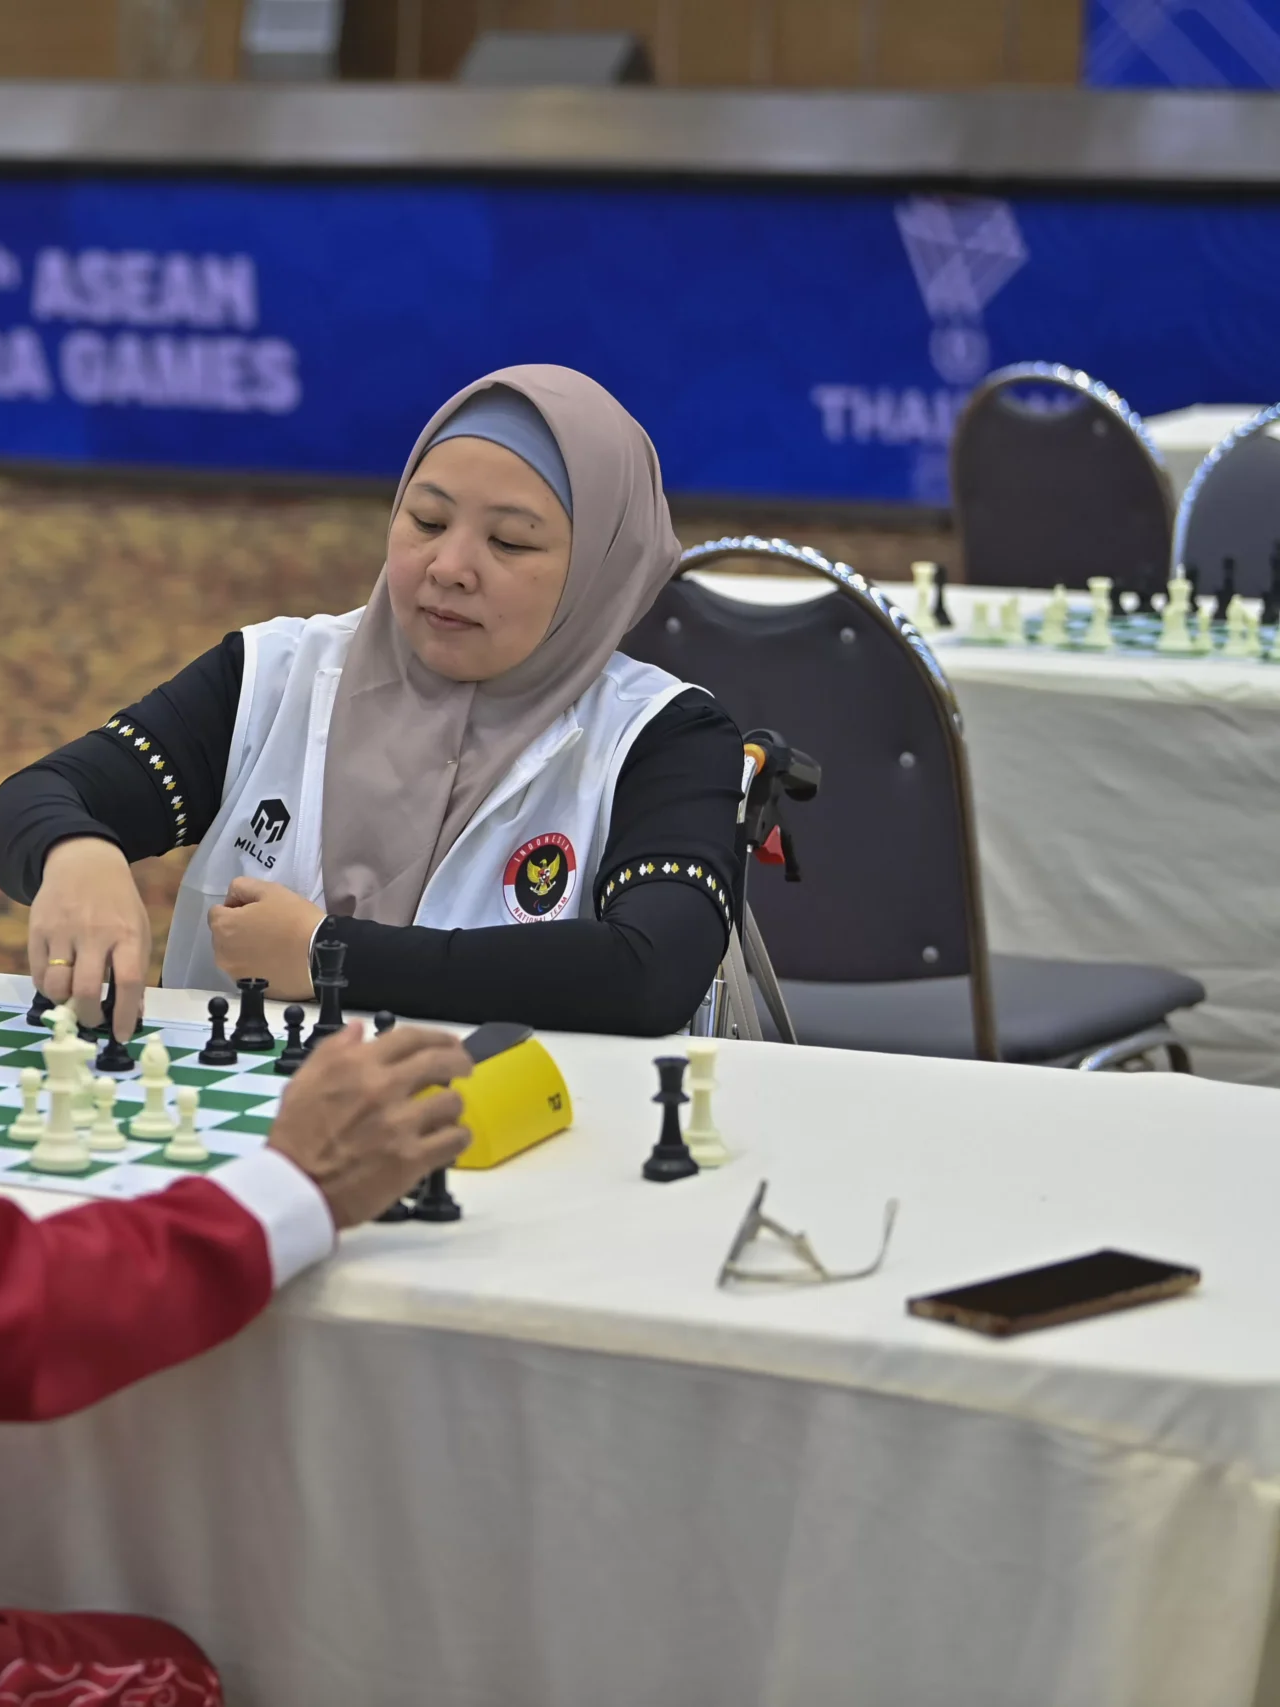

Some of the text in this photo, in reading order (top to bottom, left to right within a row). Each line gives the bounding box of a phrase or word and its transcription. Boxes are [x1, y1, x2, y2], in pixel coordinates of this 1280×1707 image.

[31, 248, 258, 330] ASEAN
[59, 331, 299, 413] GAMES
[812, 382, 960, 445] THAI
[234, 836, 276, 869] MILLS
[513, 834, 570, 863] INDONESIA
[550, 896, 568, 918] TEAM
